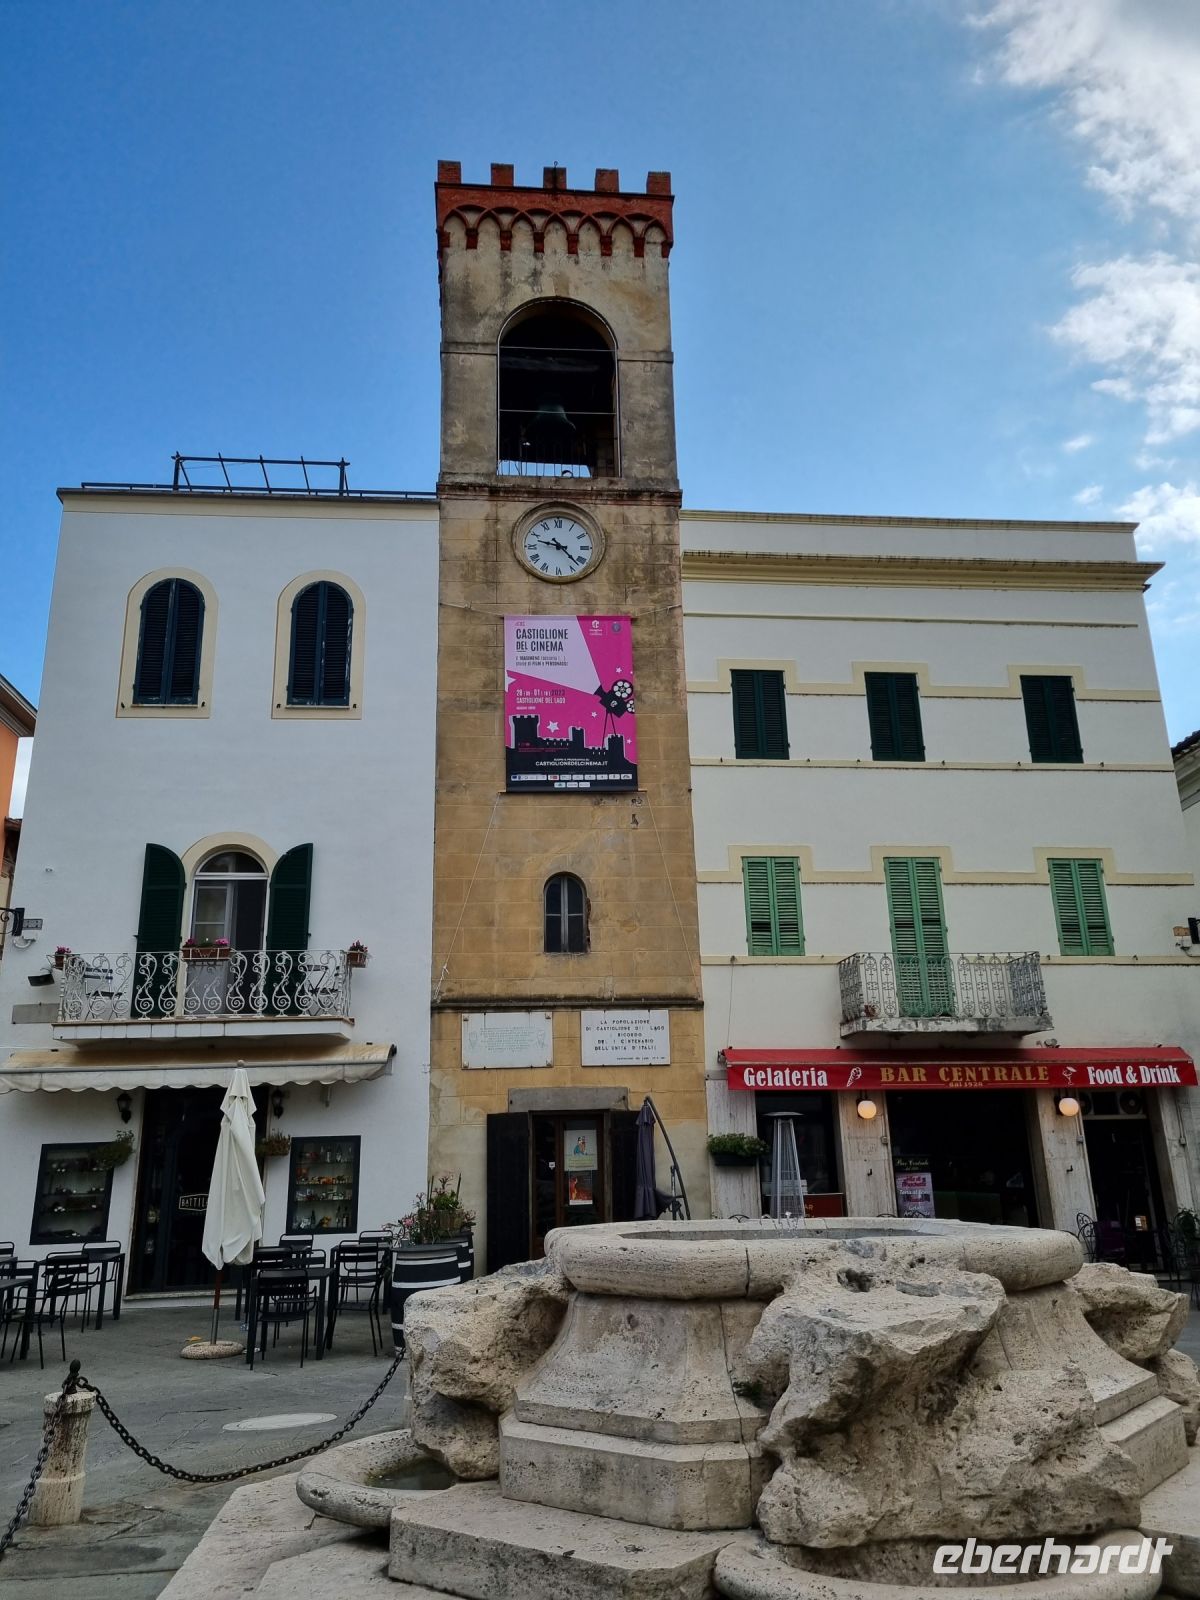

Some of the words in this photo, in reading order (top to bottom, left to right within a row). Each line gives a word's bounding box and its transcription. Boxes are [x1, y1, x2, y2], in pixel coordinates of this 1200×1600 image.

[516, 628, 568, 640] CASTIGLIONE
[516, 640, 528, 651] DEL
[530, 640, 564, 652] CINEMA
[743, 1067, 828, 1087] Gelateria
[880, 1066, 928, 1082] BAR
[938, 1066, 1049, 1082] CENTRALE
[1087, 1066, 1123, 1085] Food
[1125, 1066, 1138, 1084] &
[1139, 1065, 1181, 1084] Drink
